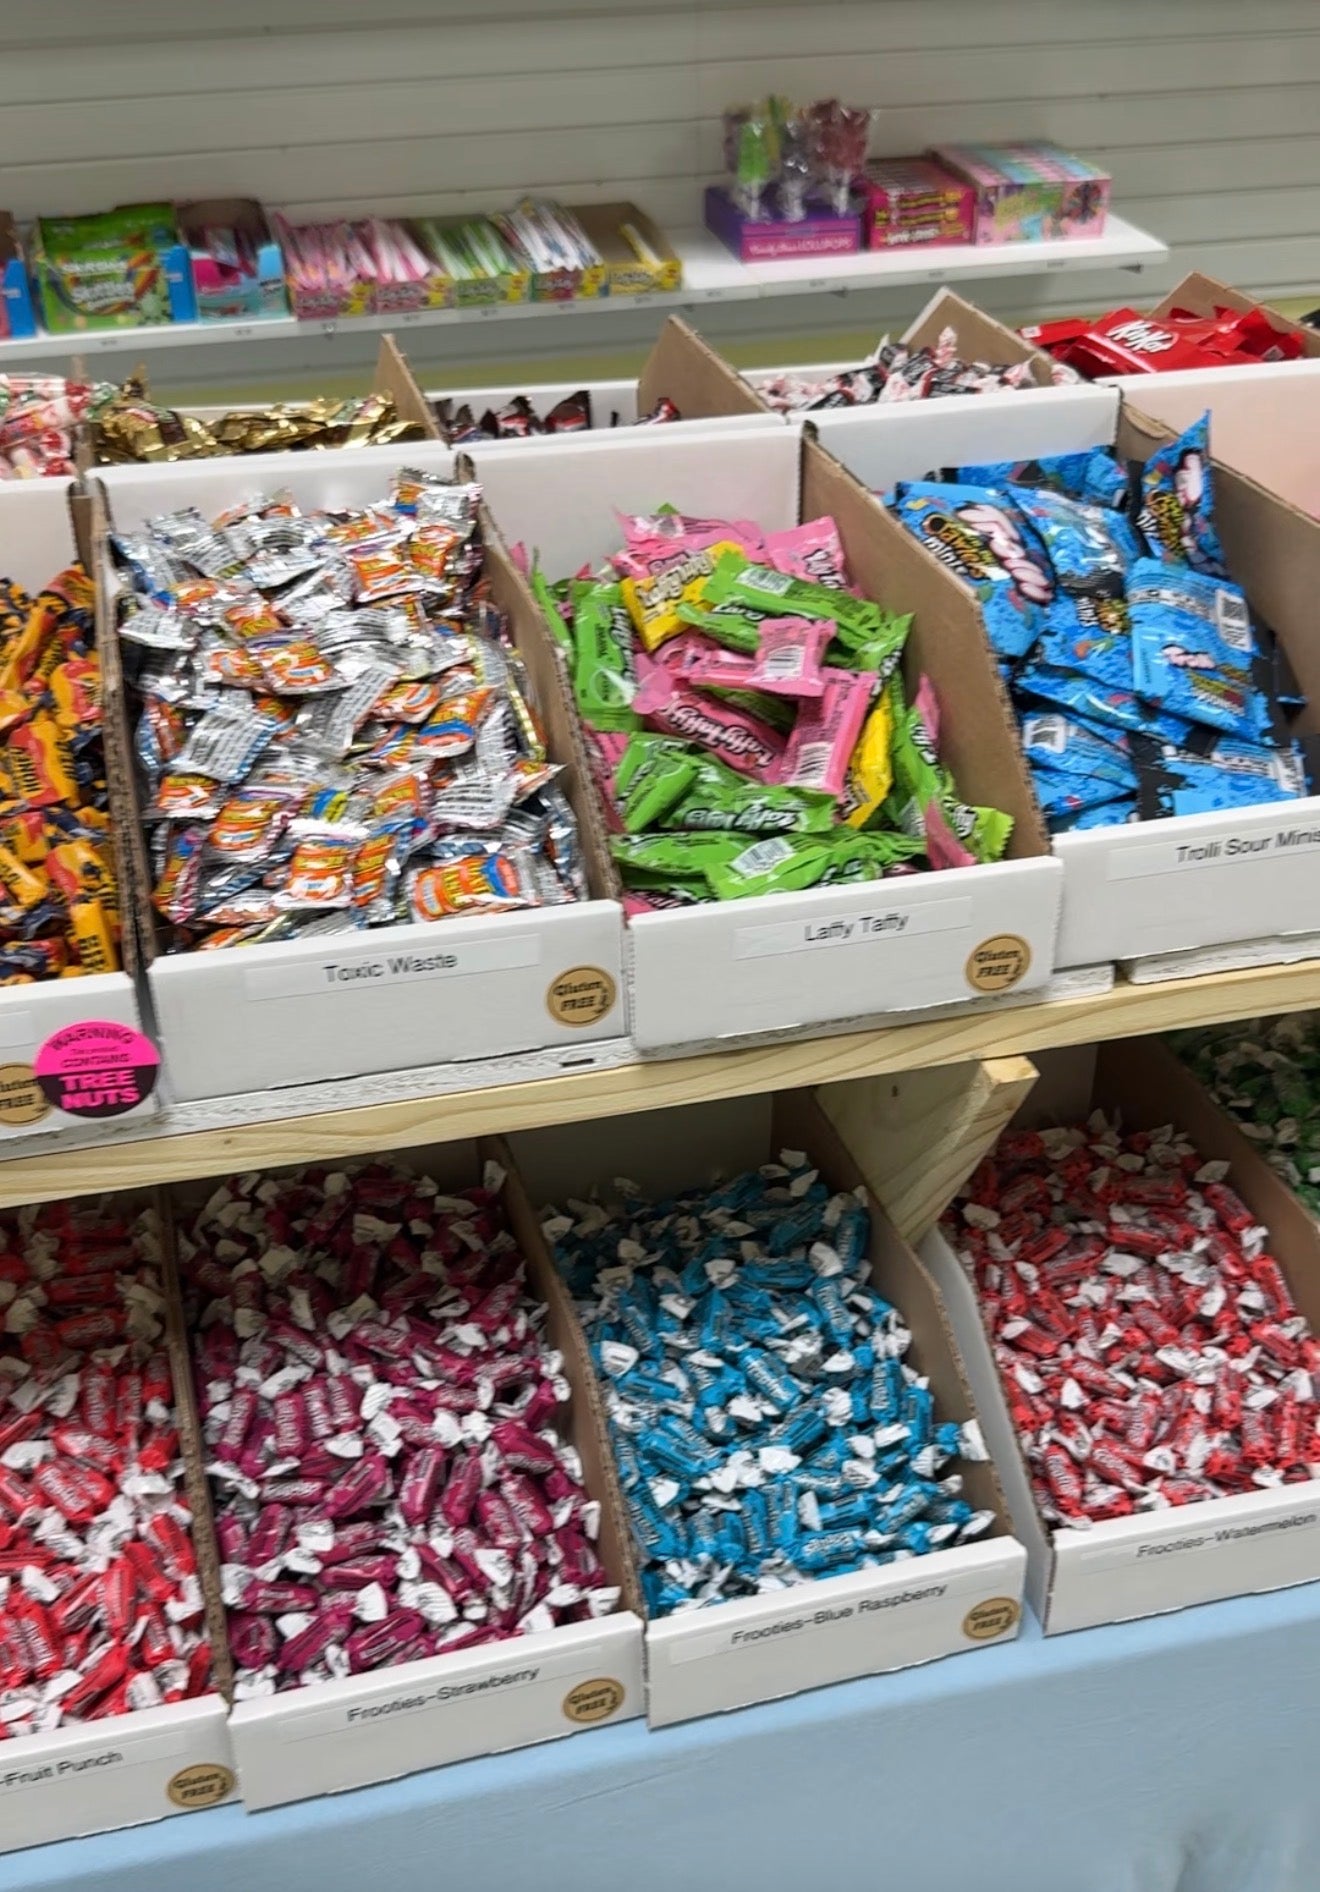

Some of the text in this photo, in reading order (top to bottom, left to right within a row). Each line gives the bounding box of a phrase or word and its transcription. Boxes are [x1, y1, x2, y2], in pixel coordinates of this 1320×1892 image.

[1176, 841, 1222, 863] Trolli
[1224, 837, 1272, 856] Sour
[803, 911, 909, 941] Laffy Taffy
[323, 952, 458, 983] Toxic Waste
[973, 949, 1020, 963] Gluten
[976, 964, 1012, 979] FREE
[552, 980, 604, 998] Gluten
[559, 994, 598, 1013] FREE
[59, 1069, 136, 1091] TREE
[61, 1086, 140, 1110] NUTS
[858, 1583, 948, 1614] Raspberry
[57, 1750, 124, 1776] Punch
[181, 1783, 216, 1800] FREE
